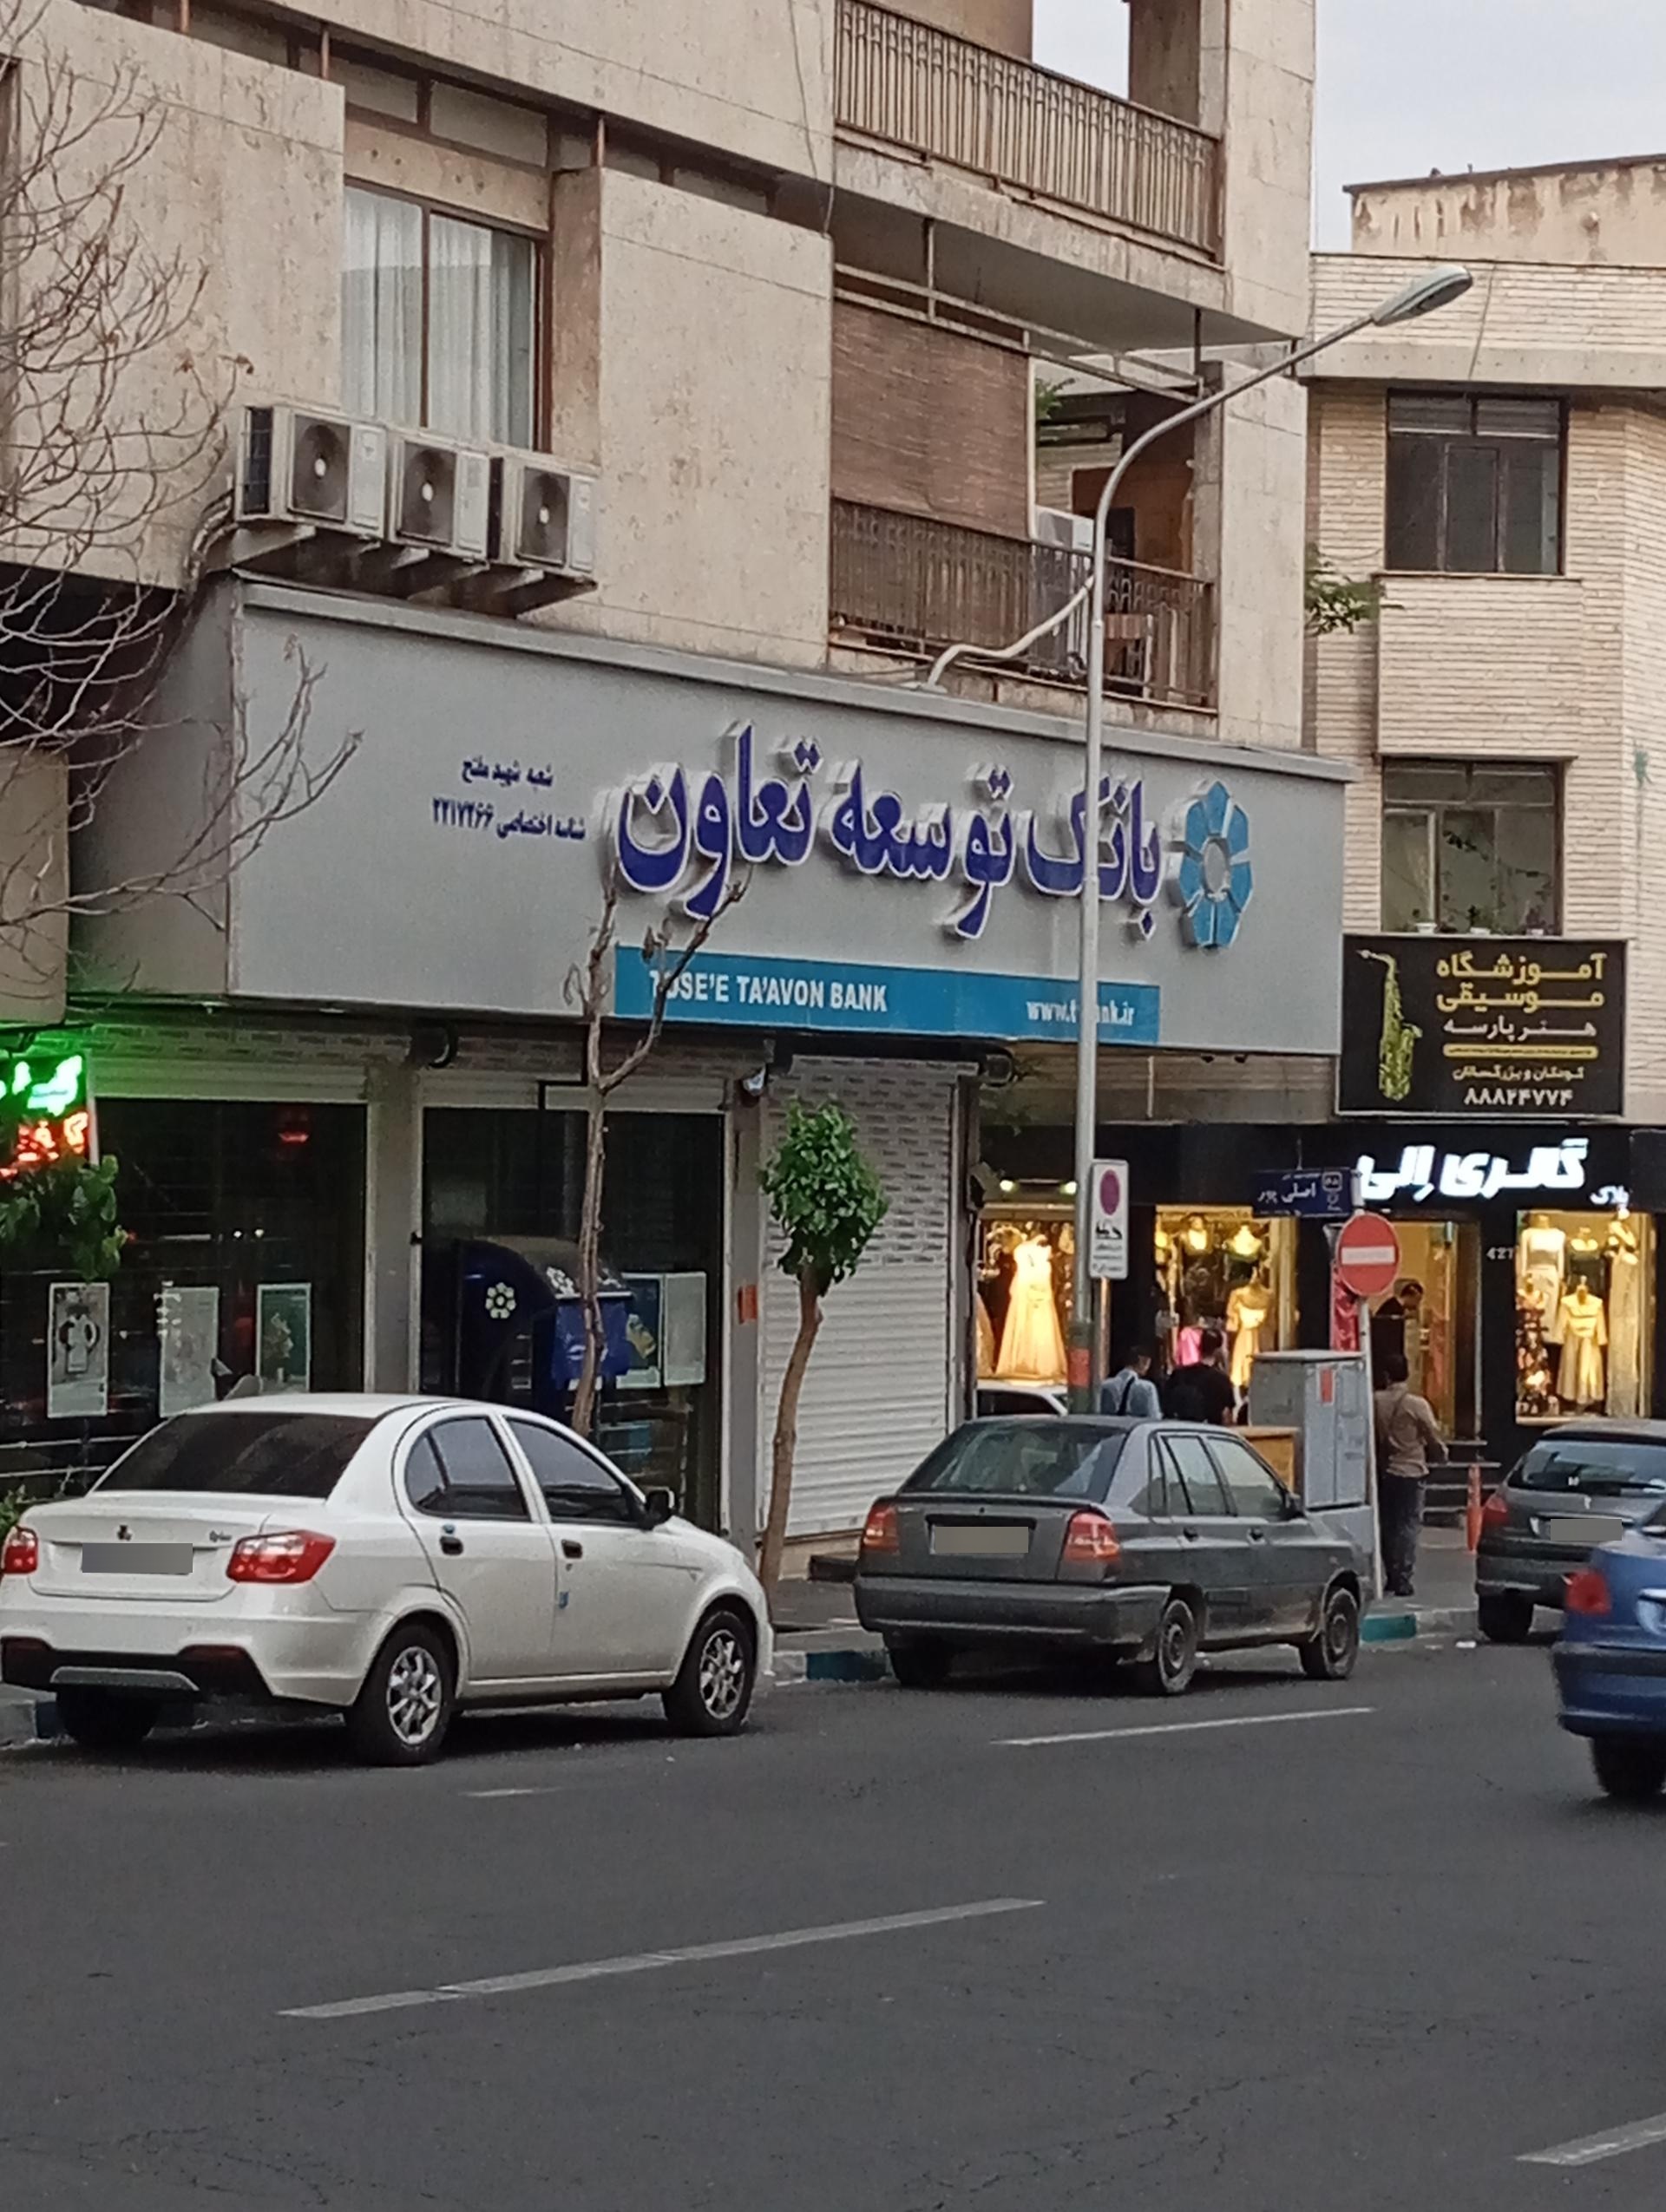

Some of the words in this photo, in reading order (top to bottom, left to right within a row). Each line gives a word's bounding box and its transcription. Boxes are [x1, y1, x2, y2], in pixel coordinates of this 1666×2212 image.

[617, 722, 823, 920] تعاون
[829, 757, 1015, 940] توسعه
[1026, 775, 1163, 939] بانک
[1436, 951, 1607, 985] آموزشگاه
[738, 975, 823, 1009] TA'AVON
[830, 982, 888, 1012] BANK
[1436, 982, 1605, 1013] موسیقی
[1443, 1015, 1515, 1042] پارسه
[1518, 1020, 1597, 1041] هنر
[1439, 1137, 1590, 1199] گالری
